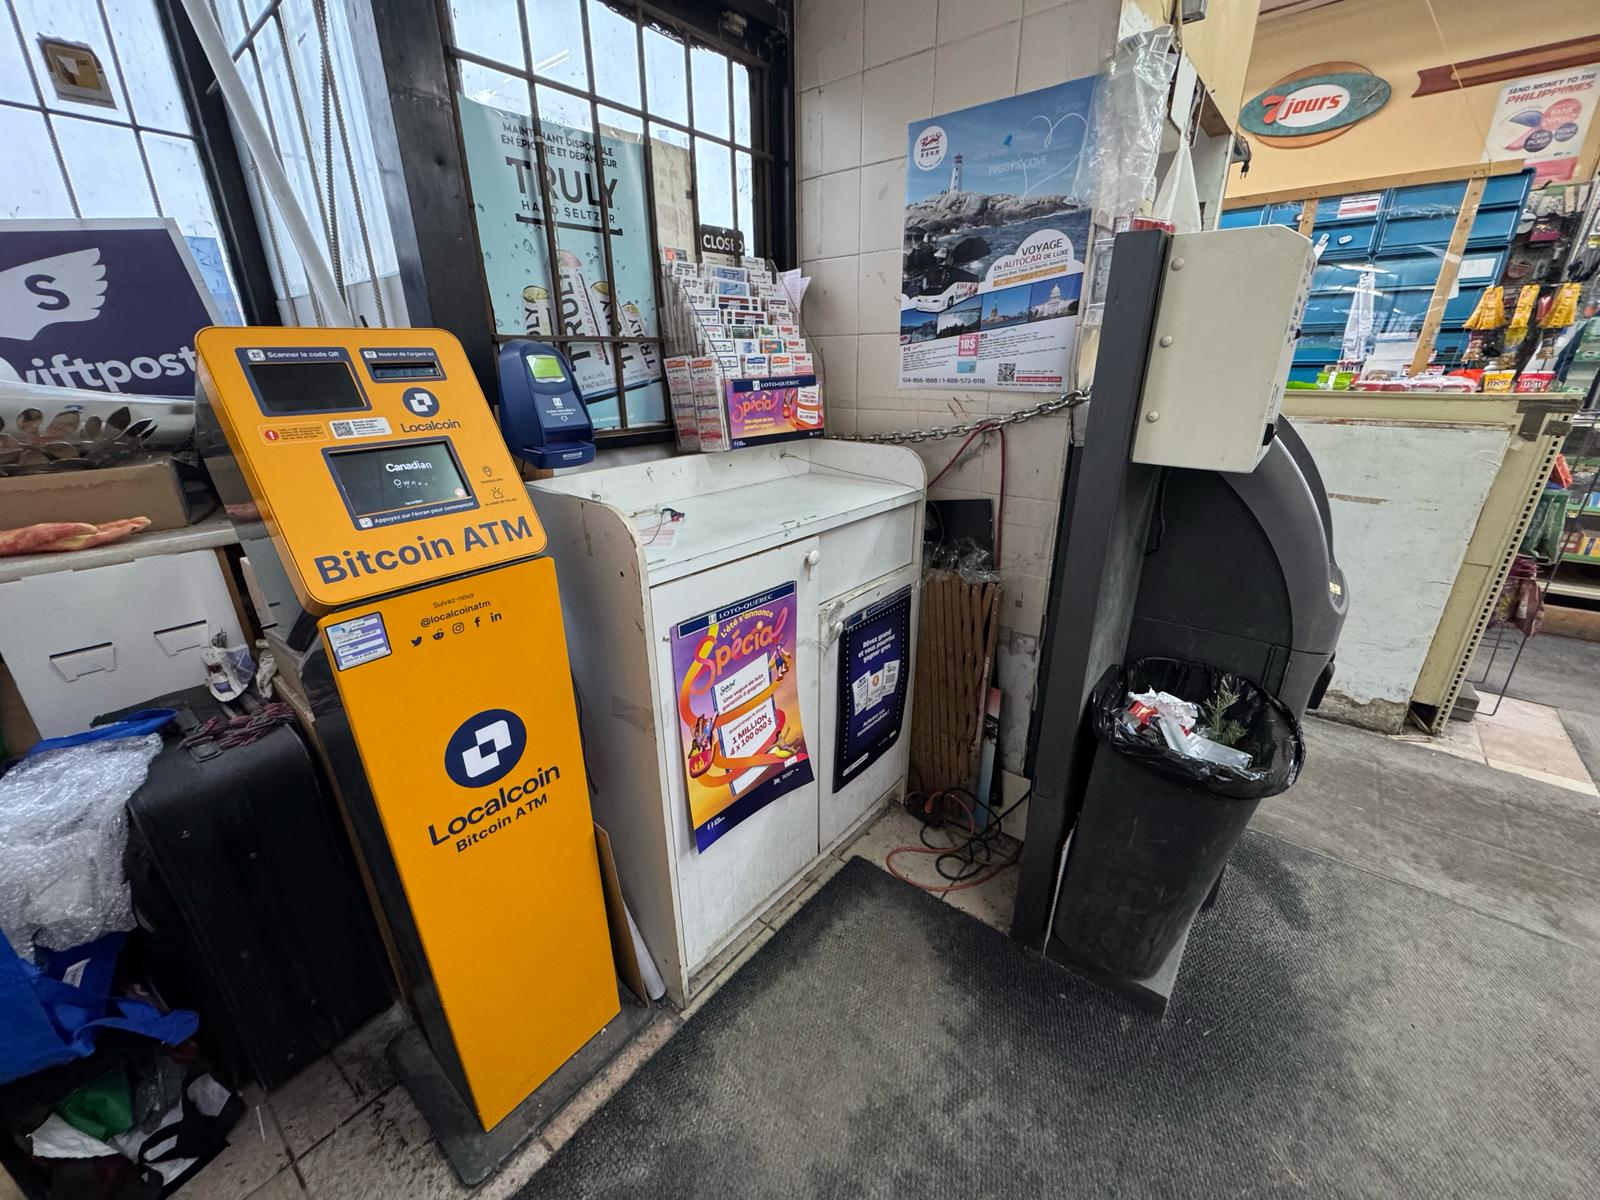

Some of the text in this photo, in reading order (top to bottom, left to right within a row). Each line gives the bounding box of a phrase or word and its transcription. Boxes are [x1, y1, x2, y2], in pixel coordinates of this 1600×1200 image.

[1505, 80, 1597, 105] PHILIPPINES
[1507, 85, 1530, 95] SEND
[1532, 79, 1565, 90] MONEY
[1567, 76, 1579, 84] TO
[1262, 94, 1343, 125] 7 jours
[502, 122, 613, 157] MAINTANT DISPOLE
[515, 135, 556, 156] ÉPICIE
[556, 147, 567, 158] ET
[569, 149, 617, 169] DÉPANEUR
[505, 156, 618, 209] TRULY
[521, 200, 616, 224] HAD SELTZR
[1003, 253, 1042, 270] AUTOCAR
[1022, 238, 1063, 256] VOYAGE
[628, 319, 657, 370] TRLY
[960, 338, 977, 351] 10$
[23, 346, 196, 394] iftpost
[401, 418, 462, 434] Localcoin
[385, 460, 433, 473] Canadian
[374, 514, 401, 525] Appuyez
[402, 512, 412, 520] sur
[431, 506, 444, 515] pour
[313, 515, 534, 585] Bitcoin ATM
[420, 600, 491, 628] @localcoinatm
[433, 592, 475, 609] Suivez-nous
[720, 608, 774, 639] L'été s'annonce
[688, 606, 788, 696] Spécial
[732, 712, 768, 745] 1 MILLION
[741, 731, 755, 748] 100
[755, 720, 768, 736] 000
[427, 766, 561, 847] Localcoin
[456, 793, 548, 853] Bitcoin ATM
